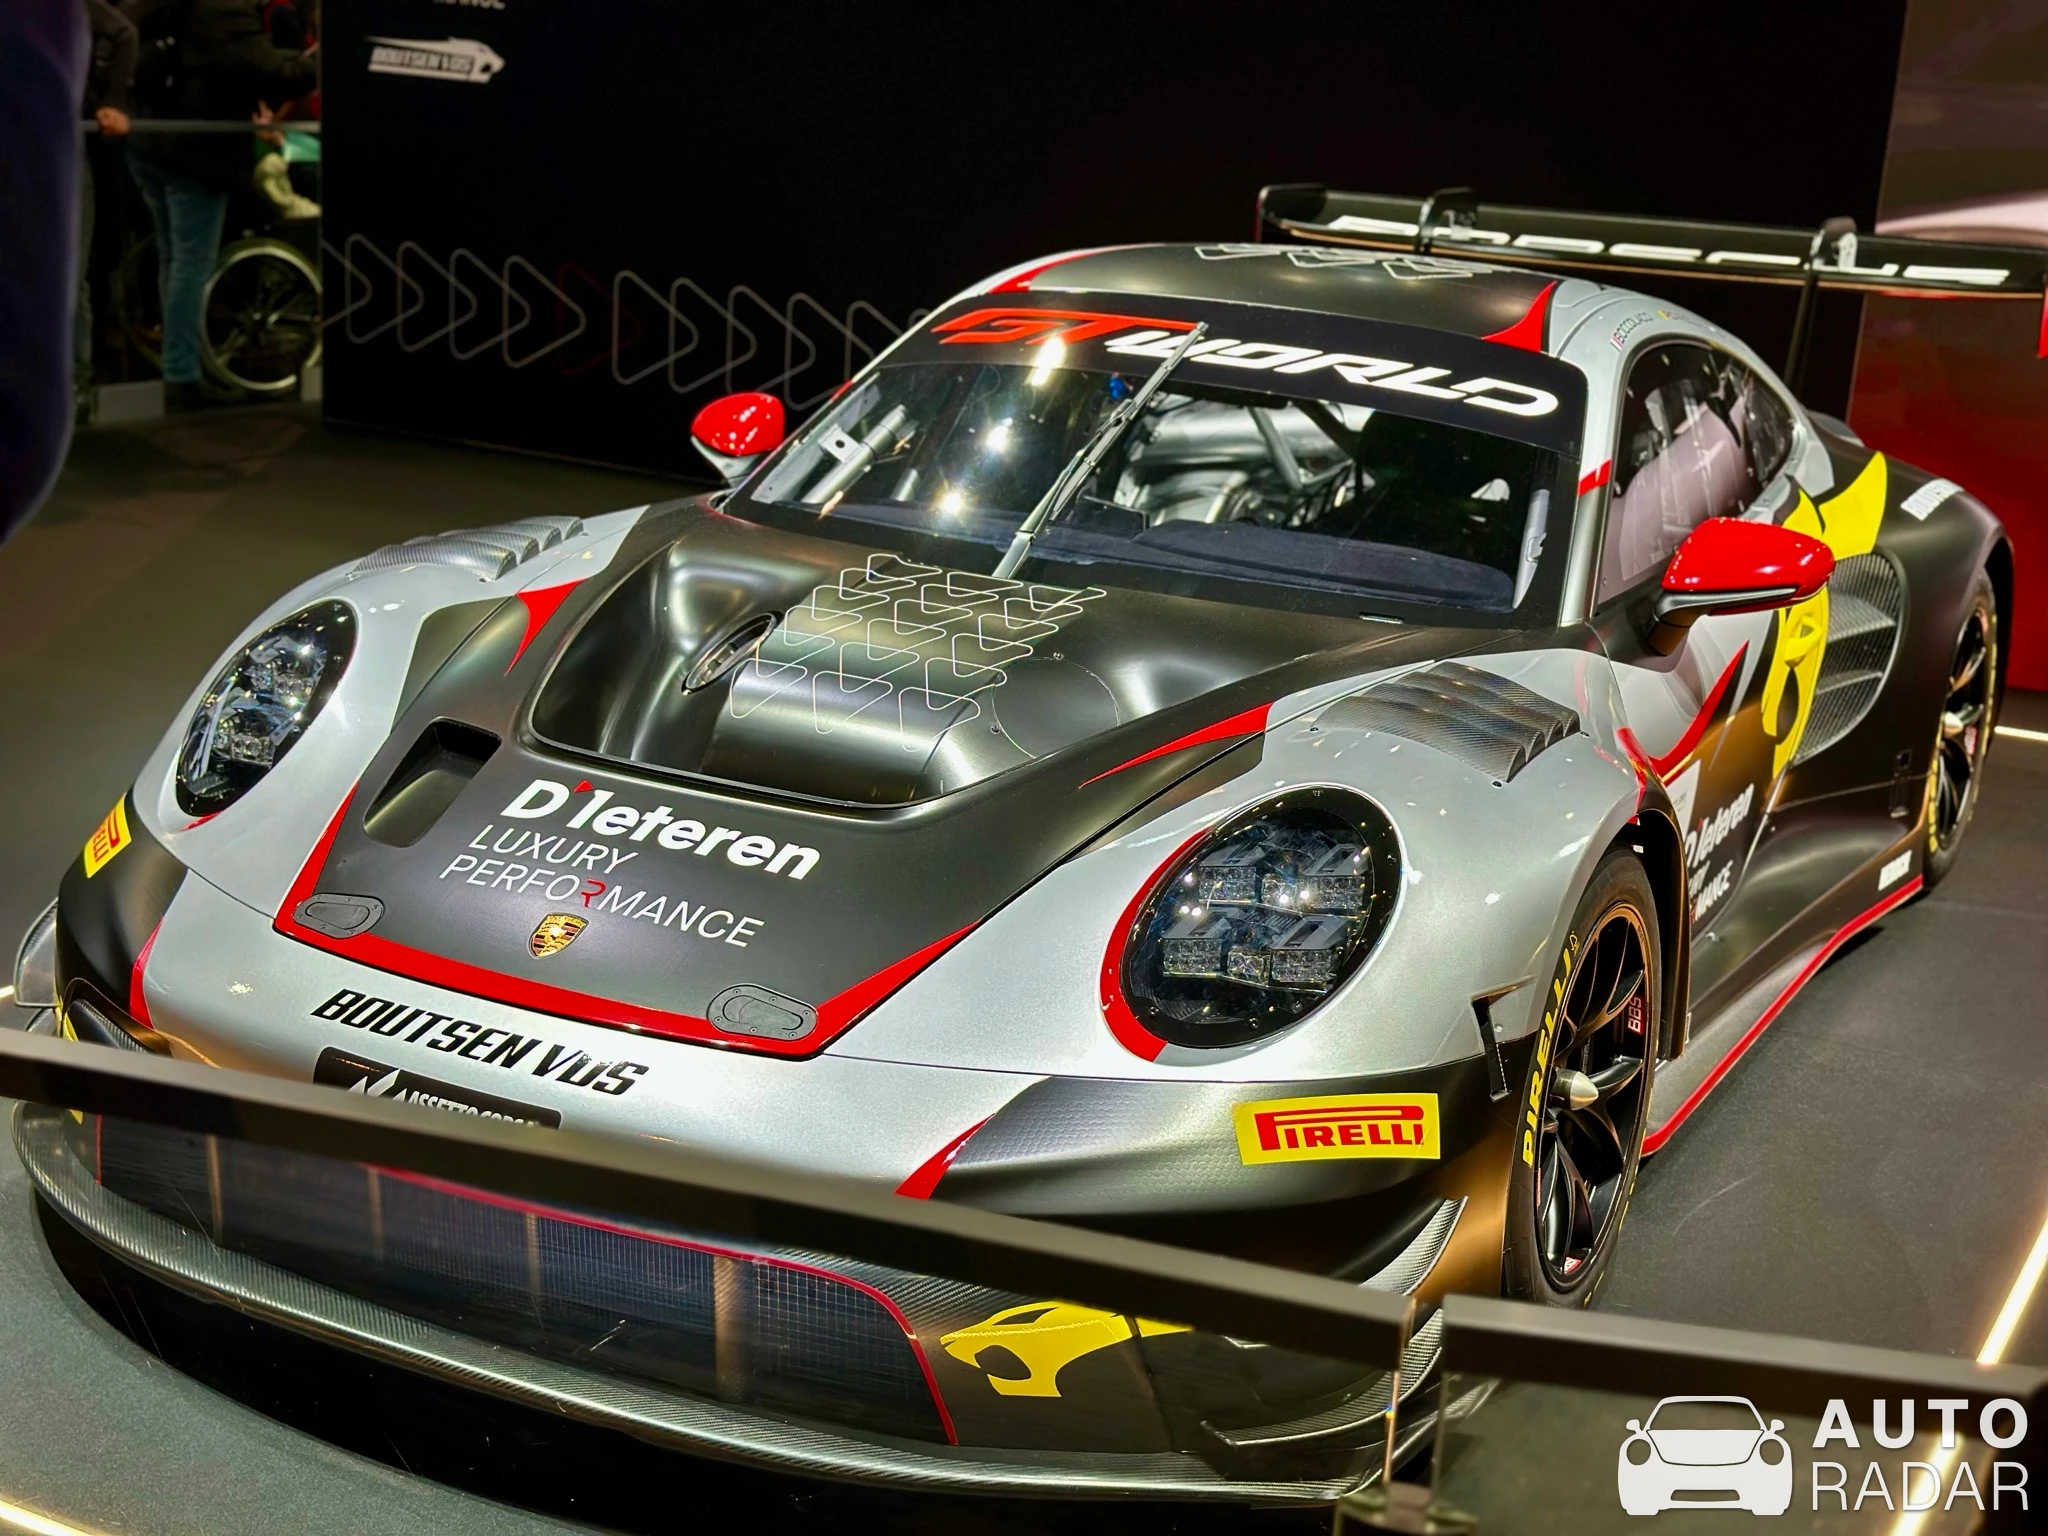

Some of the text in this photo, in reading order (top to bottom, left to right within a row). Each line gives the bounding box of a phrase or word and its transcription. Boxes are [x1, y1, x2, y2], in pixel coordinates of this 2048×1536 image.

[931, 307, 1558, 417] GT WORLD
[468, 824, 639, 875] LUXURY
[439, 854, 765, 948] PERFORMANCE
[310, 988, 543, 1069] BOUTSEN
[1628, 996, 1642, 1033] BBS
[1522, 948, 1571, 1168] PIRELLI
[1254, 1105, 1425, 1151] PIRELLI
